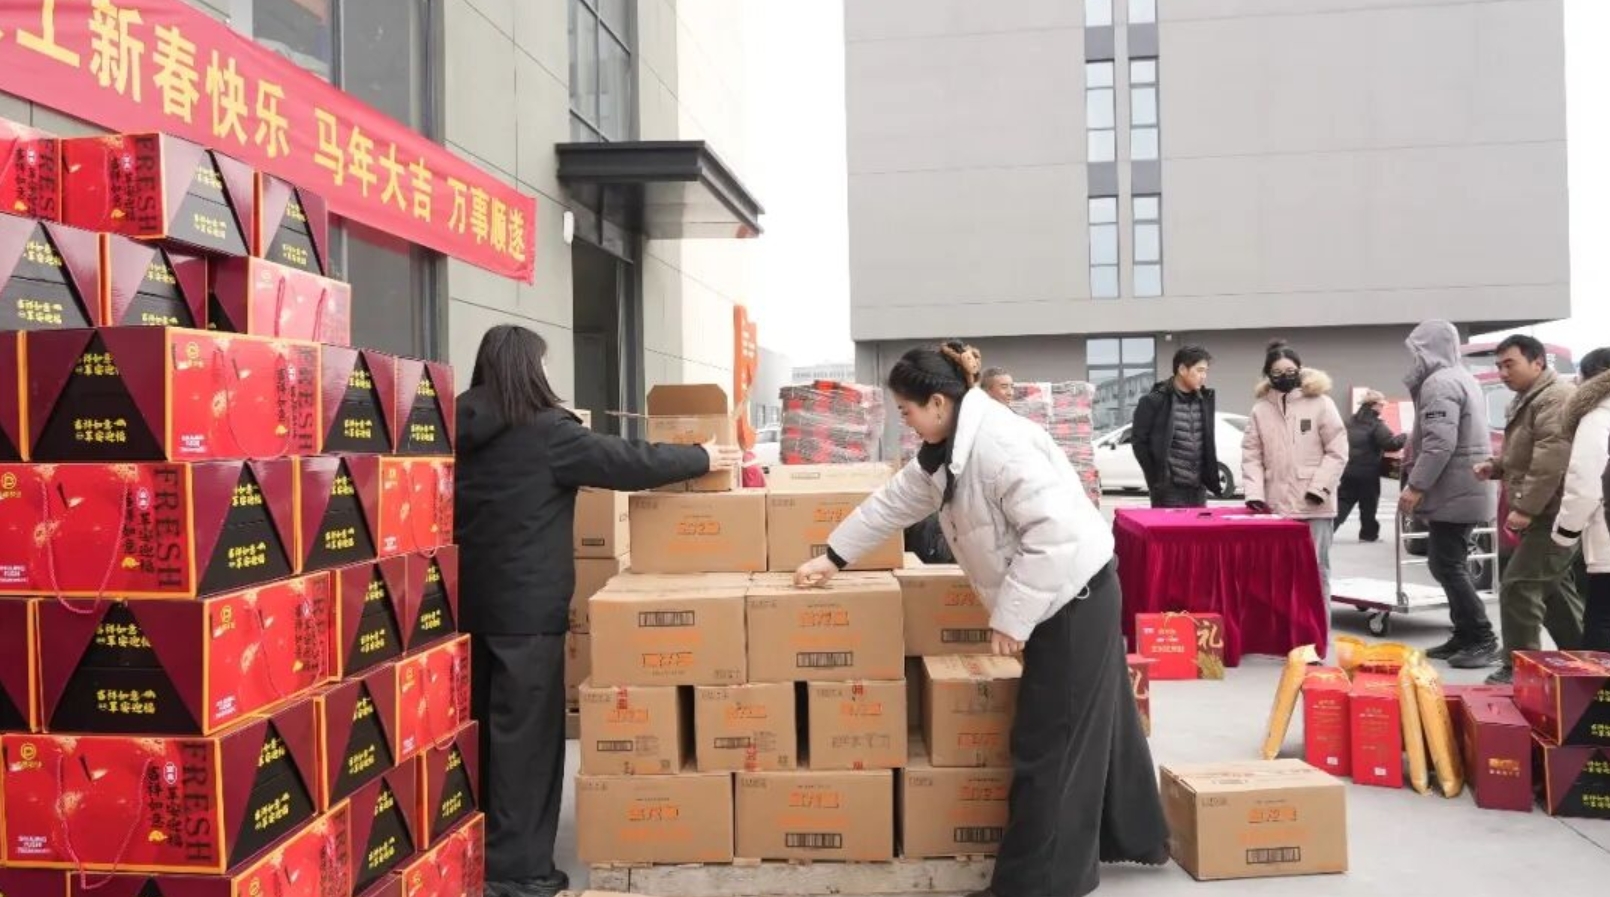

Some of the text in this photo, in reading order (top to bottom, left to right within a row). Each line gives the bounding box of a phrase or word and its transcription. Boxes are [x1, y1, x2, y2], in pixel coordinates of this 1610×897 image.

[0, 0, 526, 262] 工新春快乐 马年大吉 万事顺遂
[39, 138, 55, 219] FRES
[136, 137, 157, 231] FRESH
[299, 349, 313, 449] FRESH
[154, 467, 182, 587] FRESH
[1197, 620, 1224, 649] 礼
[182, 742, 213, 861] FRESH
